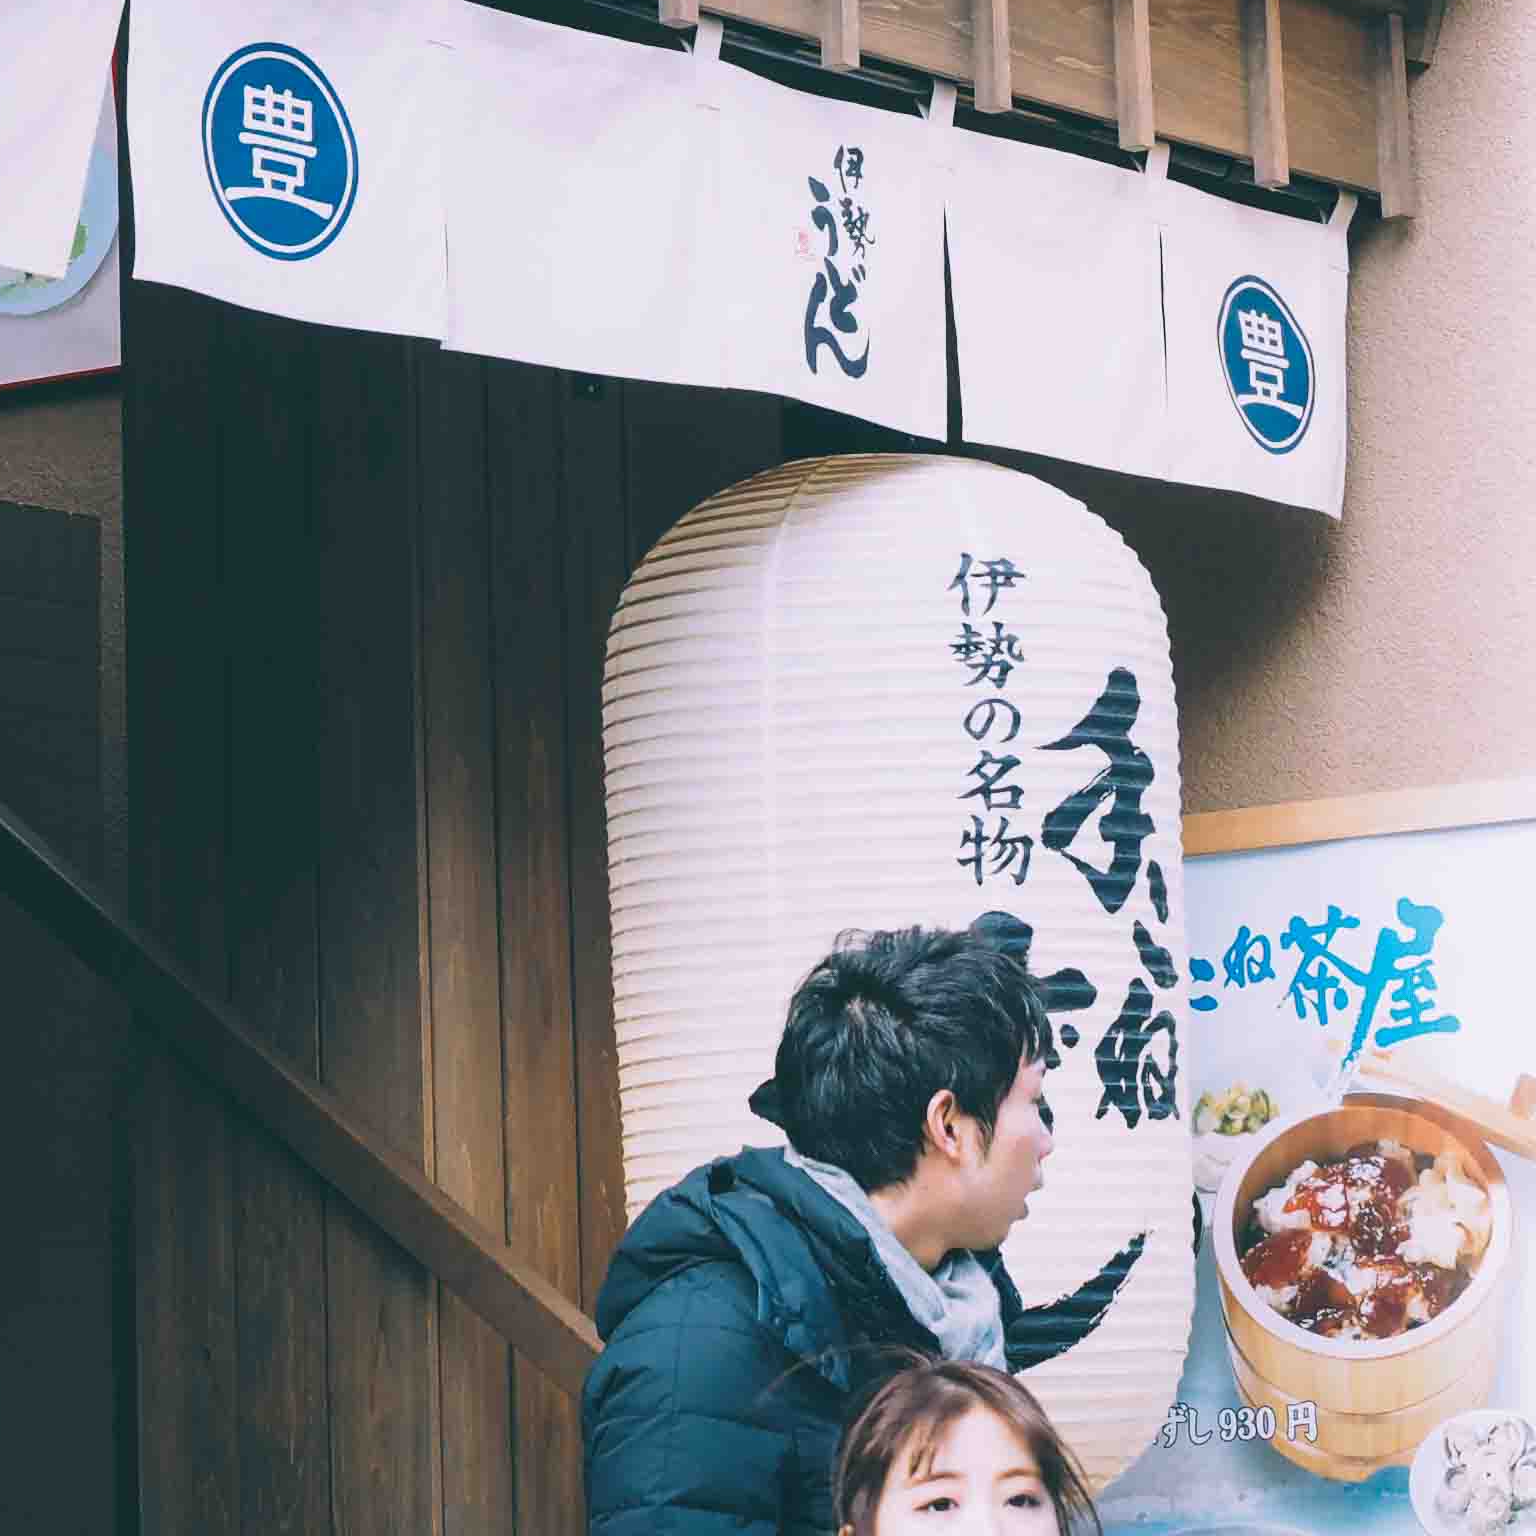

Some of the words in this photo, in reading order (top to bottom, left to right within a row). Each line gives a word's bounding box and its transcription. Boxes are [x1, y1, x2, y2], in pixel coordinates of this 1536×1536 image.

[226, 83, 333, 220] 豊
[804, 176, 870, 379] うどん
[1236, 309, 1303, 421] 豊
[948, 552, 1034, 886] 伊勢の名物
[1218, 1407, 1277, 1442] 930
[1287, 1400, 1319, 1444] 円
